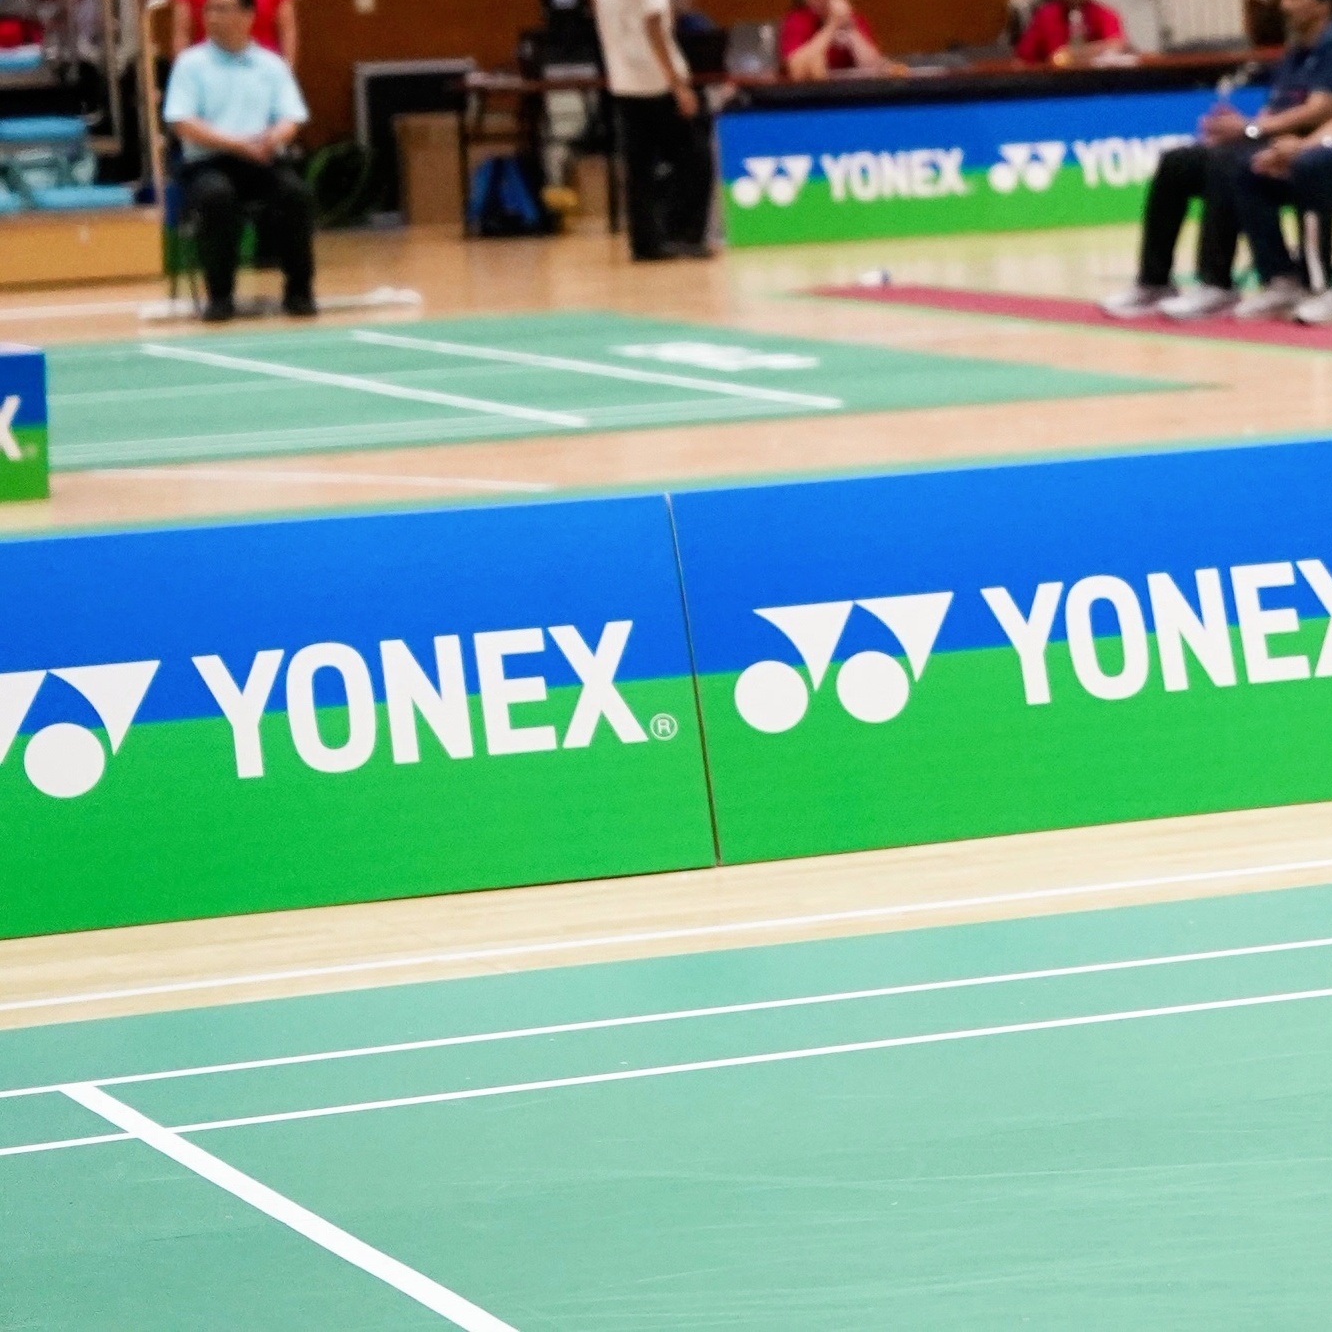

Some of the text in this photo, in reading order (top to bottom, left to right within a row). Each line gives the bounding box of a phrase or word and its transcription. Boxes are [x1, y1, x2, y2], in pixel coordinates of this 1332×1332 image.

[820, 147, 969, 203] YONEX
[1071, 134, 1196, 188] YON
[192, 620, 649, 779] YONEX
